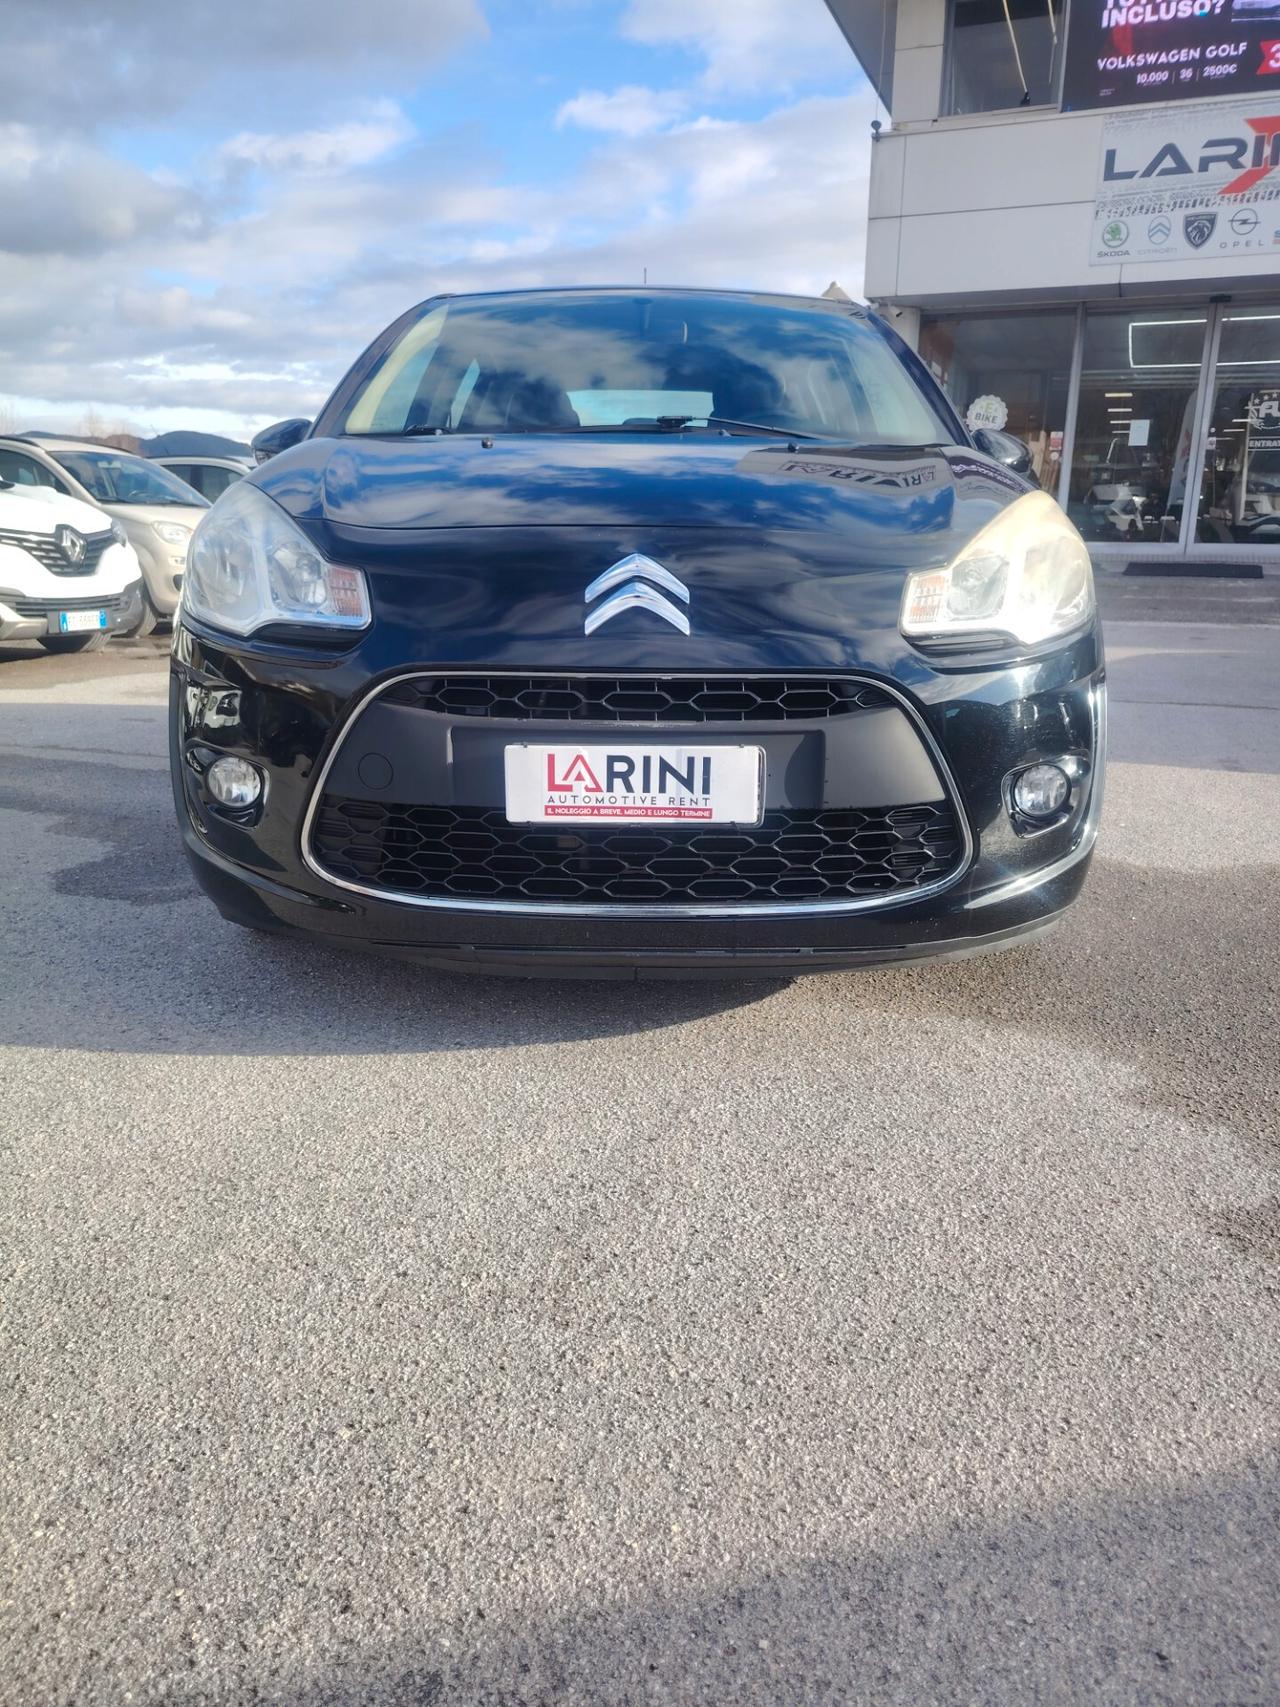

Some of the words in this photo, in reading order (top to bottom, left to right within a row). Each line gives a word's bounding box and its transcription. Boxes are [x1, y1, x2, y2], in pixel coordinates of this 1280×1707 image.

[1101, 0, 1227, 29] INCLUSO?
[1097, 48, 1200, 71] VOLKSWAGEN
[1205, 41, 1247, 58] GOLF
[1219, 239, 1265, 249] OPEL
[975, 412, 999, 424] BIKE
[547, 753, 711, 795] LARINI
[547, 795, 657, 806] AUTOMOTIVE
[669, 797, 711, 807] RENT
